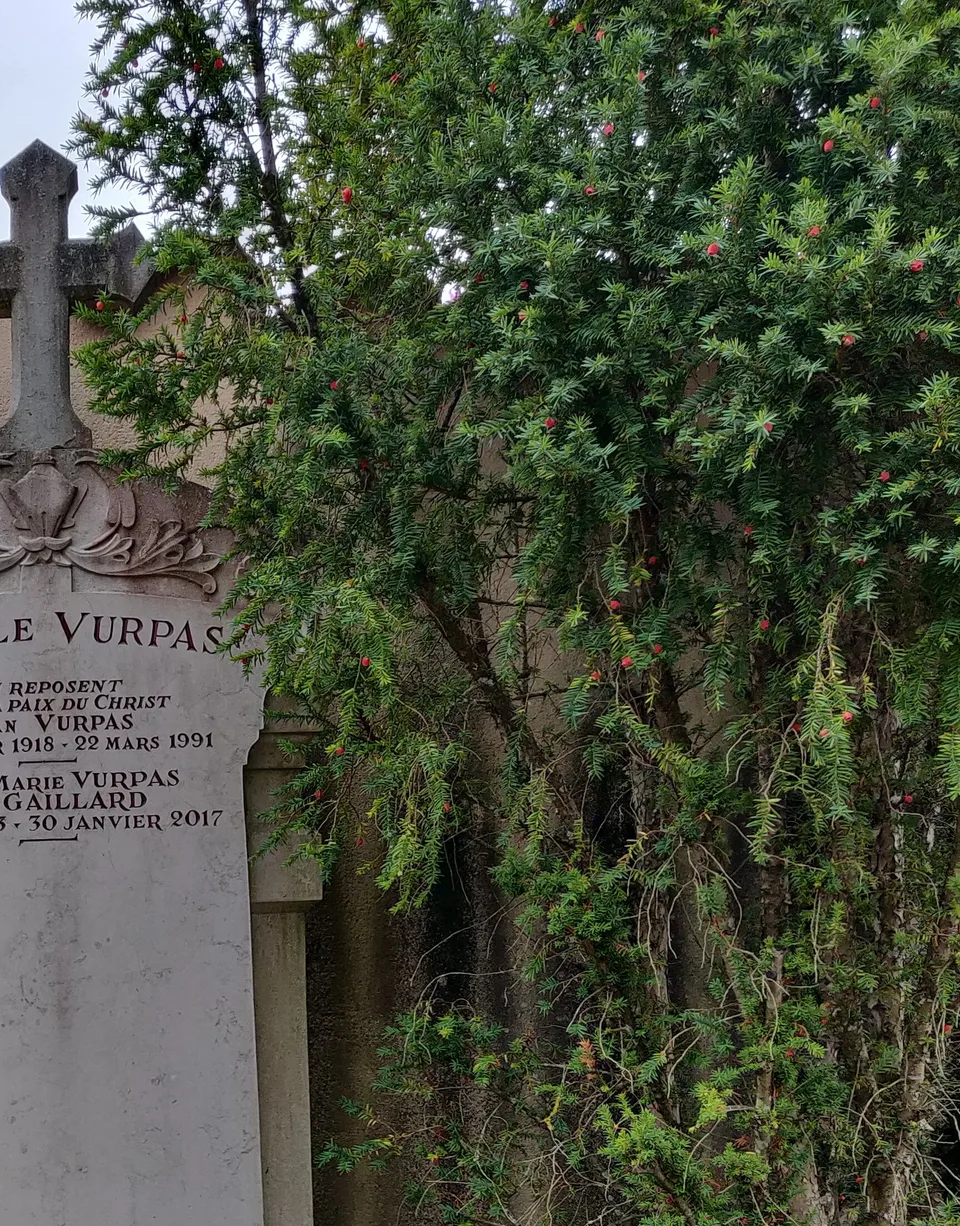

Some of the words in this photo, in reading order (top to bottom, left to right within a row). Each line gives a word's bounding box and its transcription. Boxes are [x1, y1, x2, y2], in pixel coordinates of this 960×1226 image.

[54, 612, 225, 655] VURPAS
[9, 679, 123, 697] REPOSENT
[7, 698, 55, 713] PAIX
[61, 698, 89, 711] DU
[94, 694, 171, 711] CHRIST
[34, 712, 134, 733] VURPAS
[12, 736, 54, 753] 1918
[75, 735, 99, 751] 22
[105, 736, 160, 752] MARS
[169, 732, 213, 749] 1991
[71, 769, 180, 790] VURPAS
[3, 791, 147, 812] GAILLARD
[29, 815, 57, 832] 30
[64, 814, 163, 831] JANVIER
[170, 810, 223, 827] 2017
